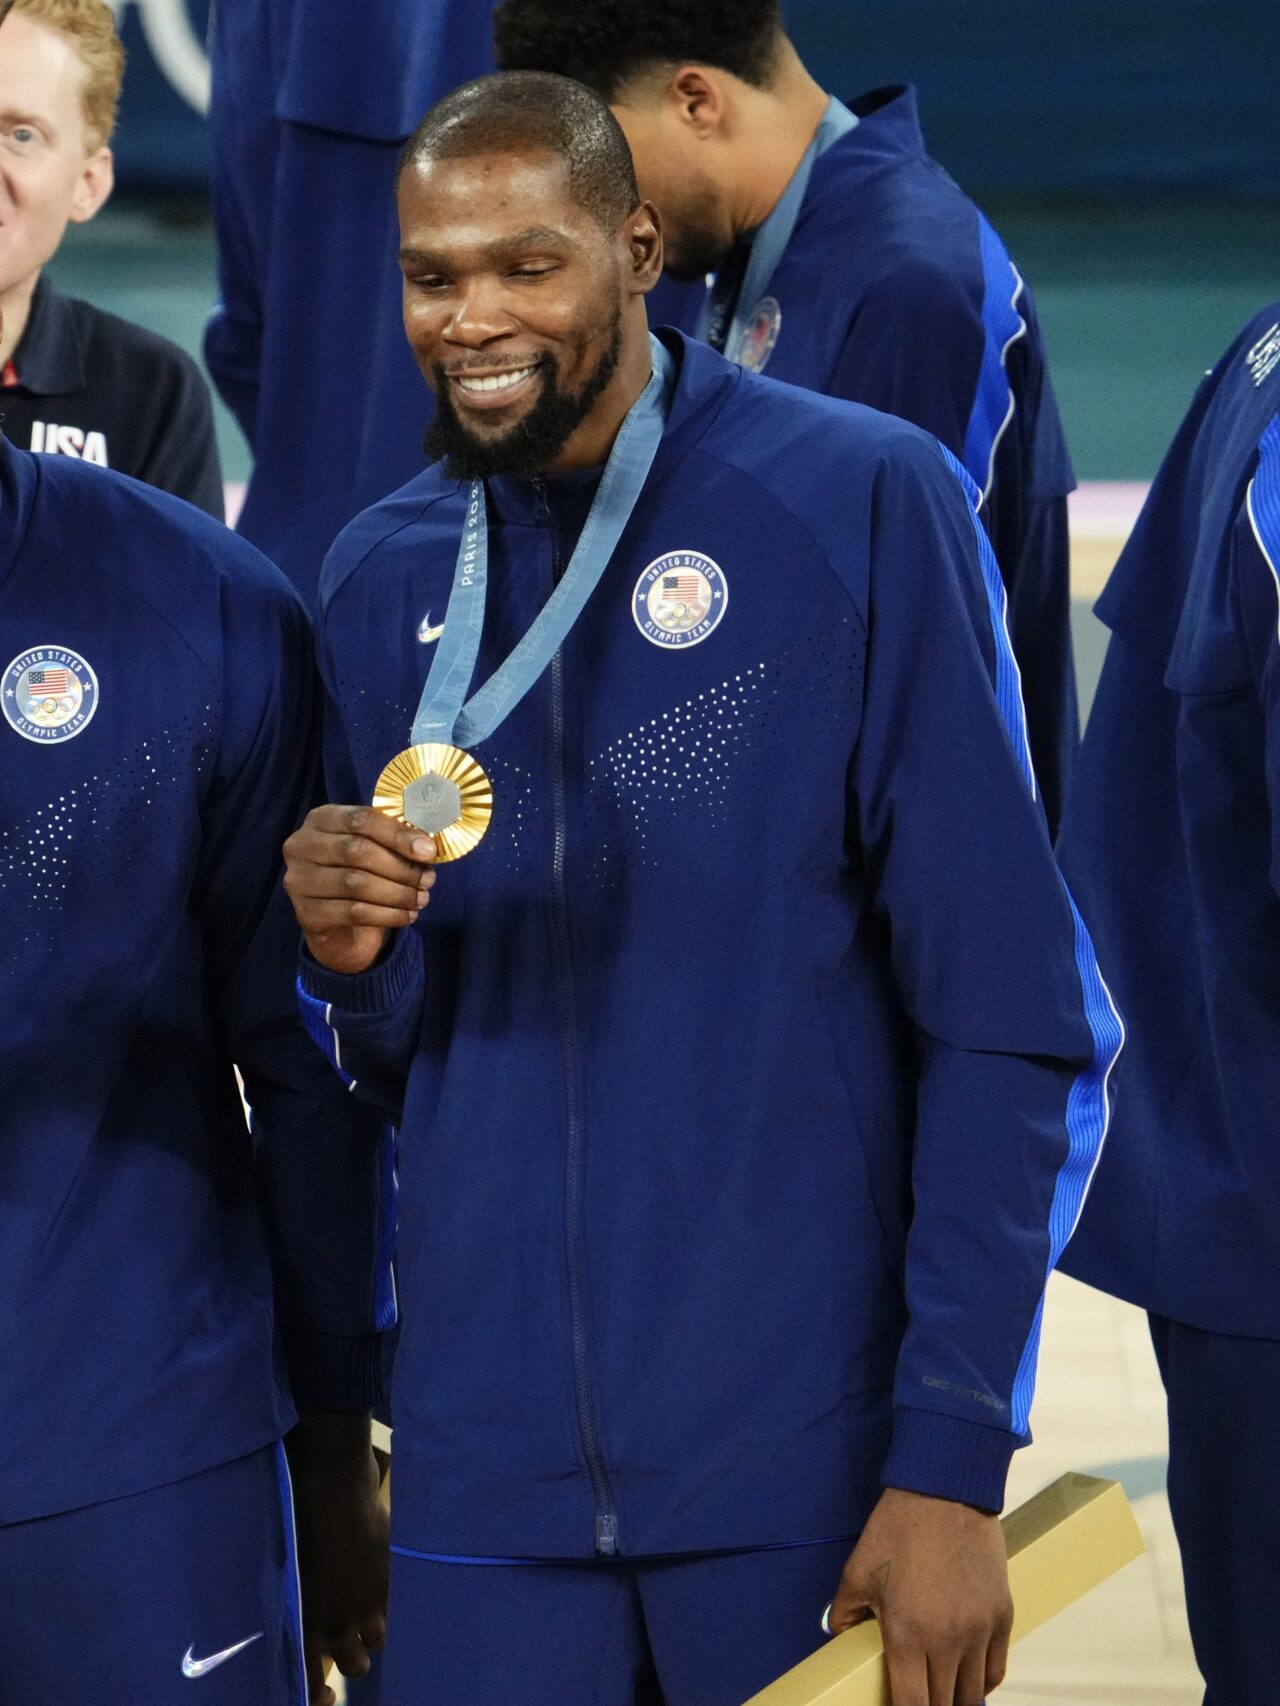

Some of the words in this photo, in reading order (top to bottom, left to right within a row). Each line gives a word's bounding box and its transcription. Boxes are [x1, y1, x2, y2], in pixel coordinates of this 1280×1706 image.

[30, 420, 108, 468] USA
[461, 531, 477, 586] PARIS
[646, 557, 680, 581] UNITED
[684, 556, 717, 580] STATES
[644, 621, 682, 643] OLYMPIC
[687, 619, 712, 640] TEAM
[11, 651, 44, 677] UNITED
[47, 651, 83, 673] STATES
[16, 716, 58, 737] OLYMPIC
[62, 713, 86, 734] TEAM
